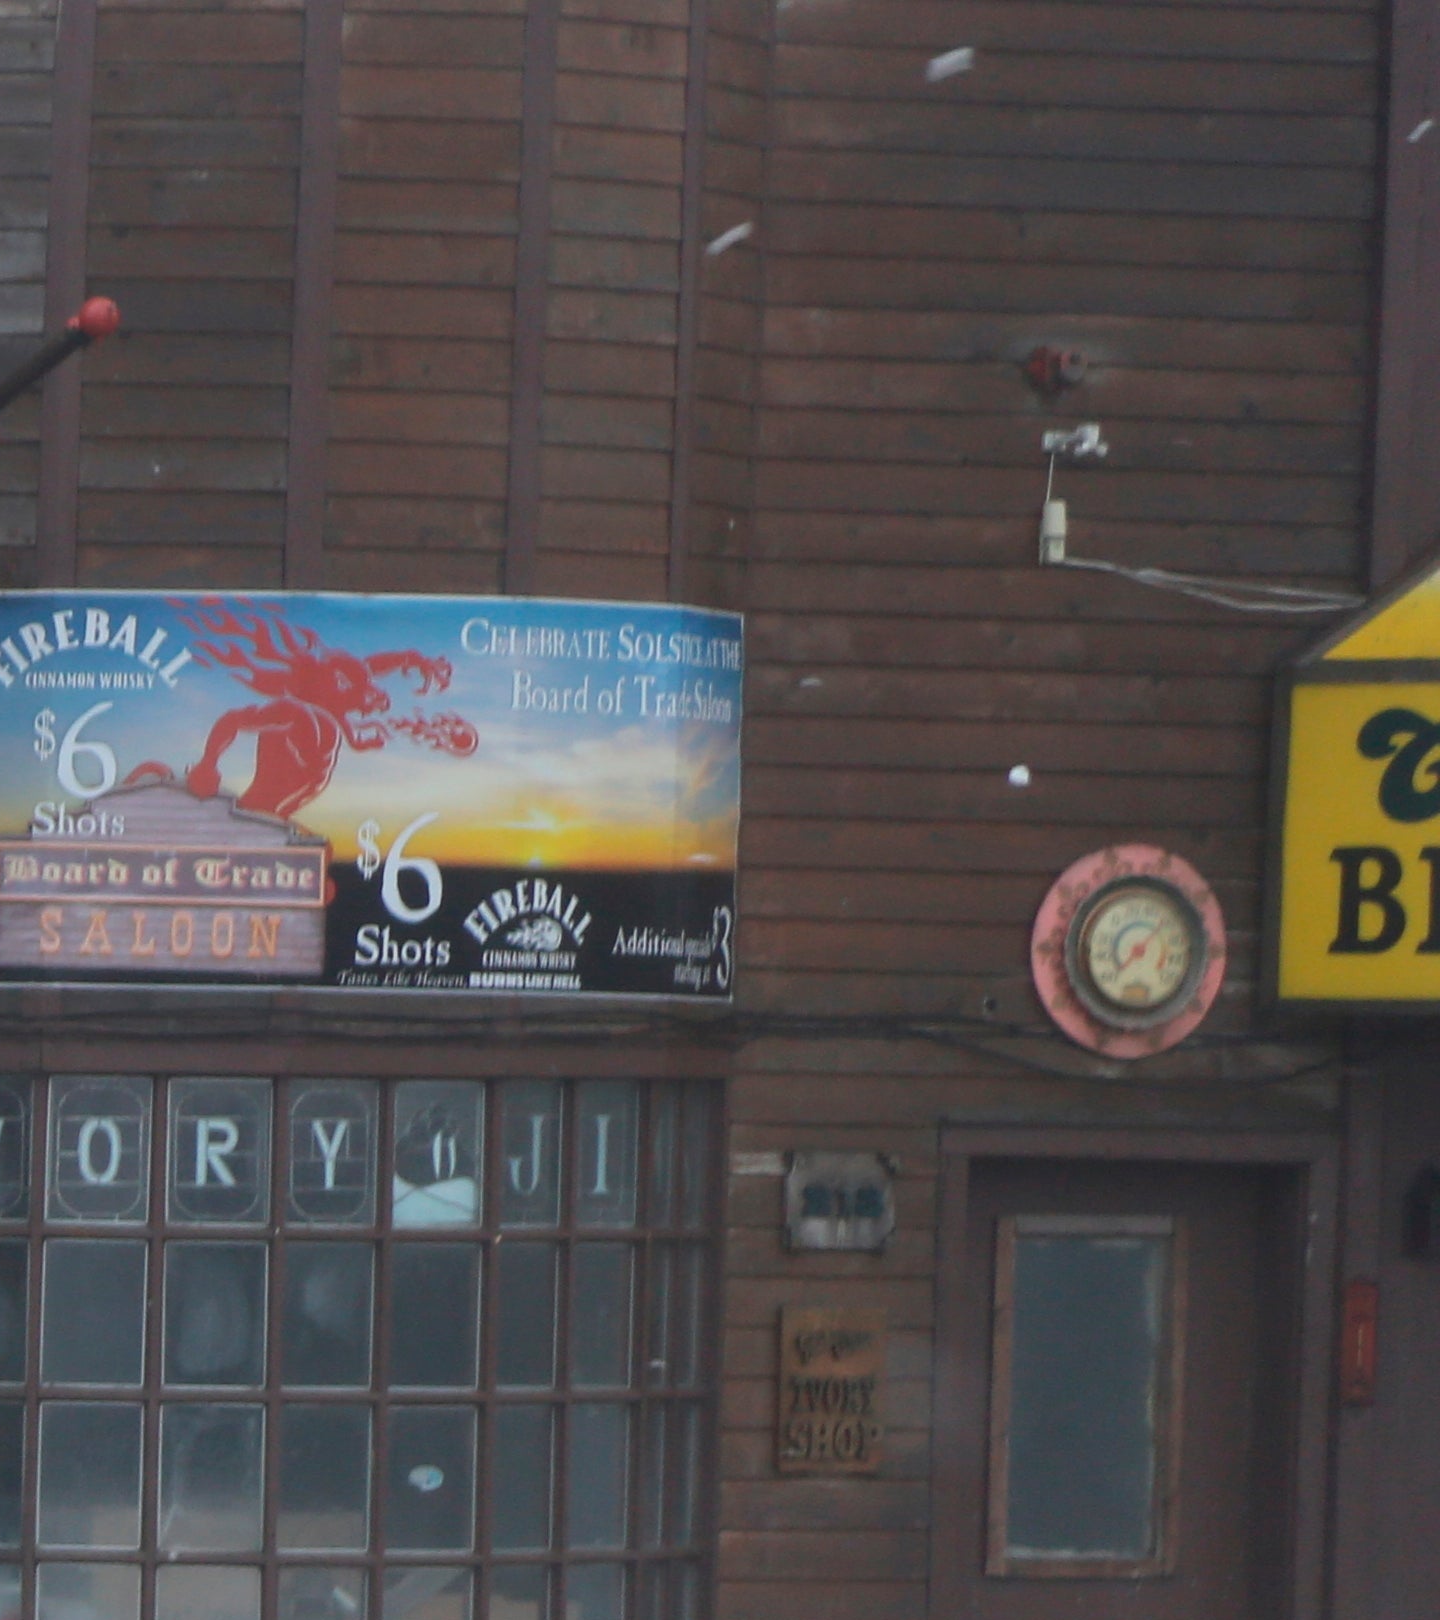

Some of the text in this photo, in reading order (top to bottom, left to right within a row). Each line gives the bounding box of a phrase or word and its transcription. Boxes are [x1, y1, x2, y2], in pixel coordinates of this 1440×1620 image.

[460, 616, 612, 660] CELEBRATE
[25, 671, 156, 690] CINNAMON WHISKY
[511, 669, 589, 712] Board
[597, 676, 626, 717] of
[633, 675, 691, 719] Trade
[33, 700, 118, 799] $6
[32, 800, 125, 838] Shots
[3, 854, 316, 888] Board of Trade
[357, 811, 443, 925] $6
[39, 906, 282, 959] SALOON
[463, 877, 593, 946] FIREBALL
[355, 923, 451, 967] Shots
